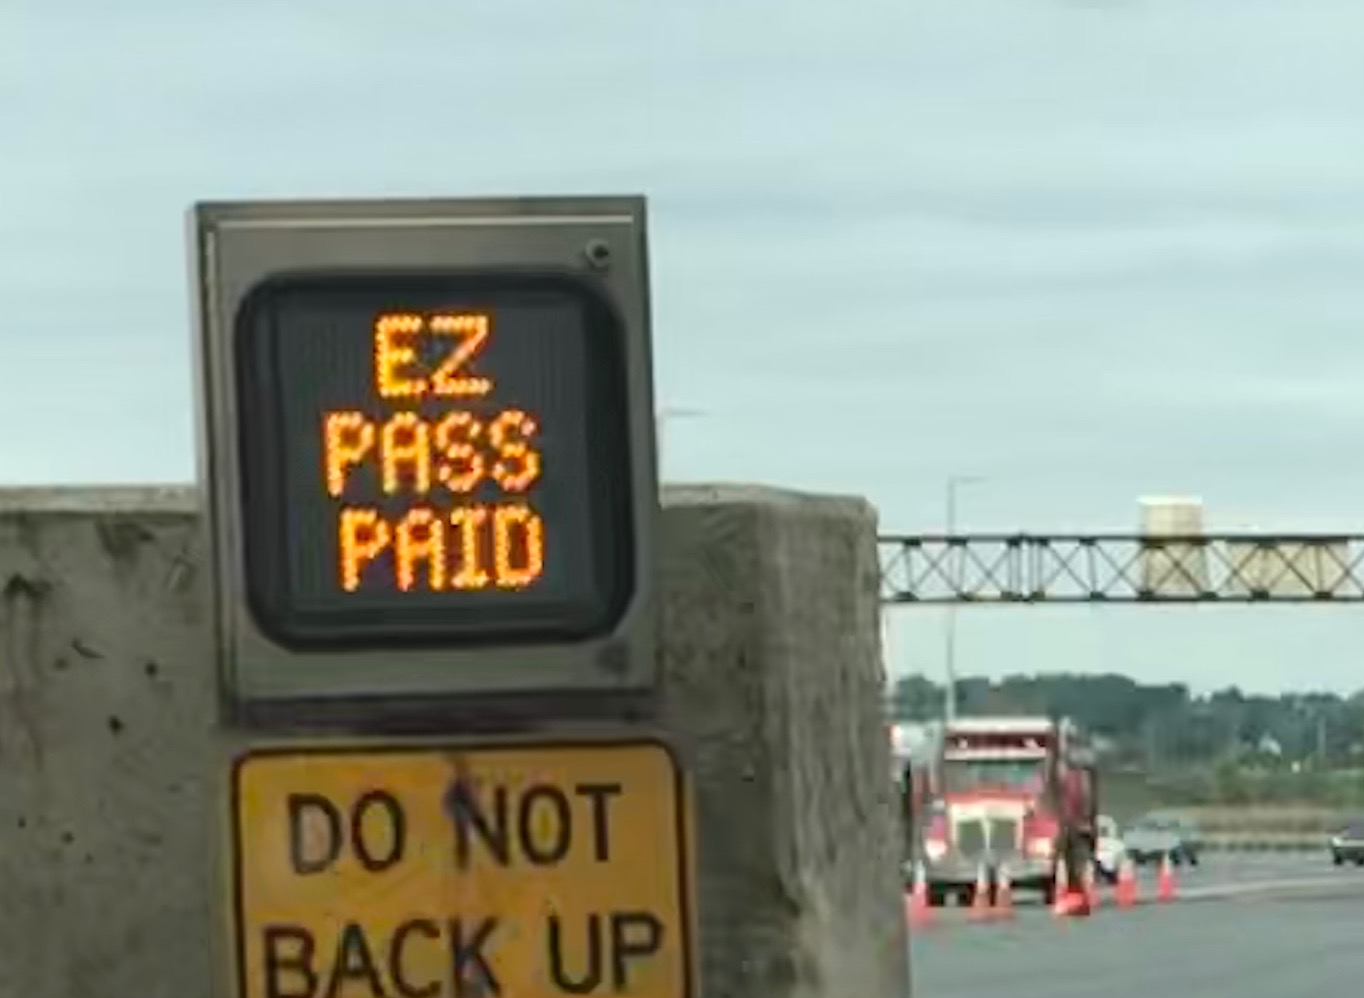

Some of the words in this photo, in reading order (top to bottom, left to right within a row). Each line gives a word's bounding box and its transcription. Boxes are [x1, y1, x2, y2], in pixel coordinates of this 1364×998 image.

[374, 314, 493, 398] EZ
[323, 410, 542, 498] PASS
[339, 504, 545, 593] PAID
[287, 788, 407, 876] DO
[446, 782, 622, 870] NOT
[547, 910, 664, 996] UP
